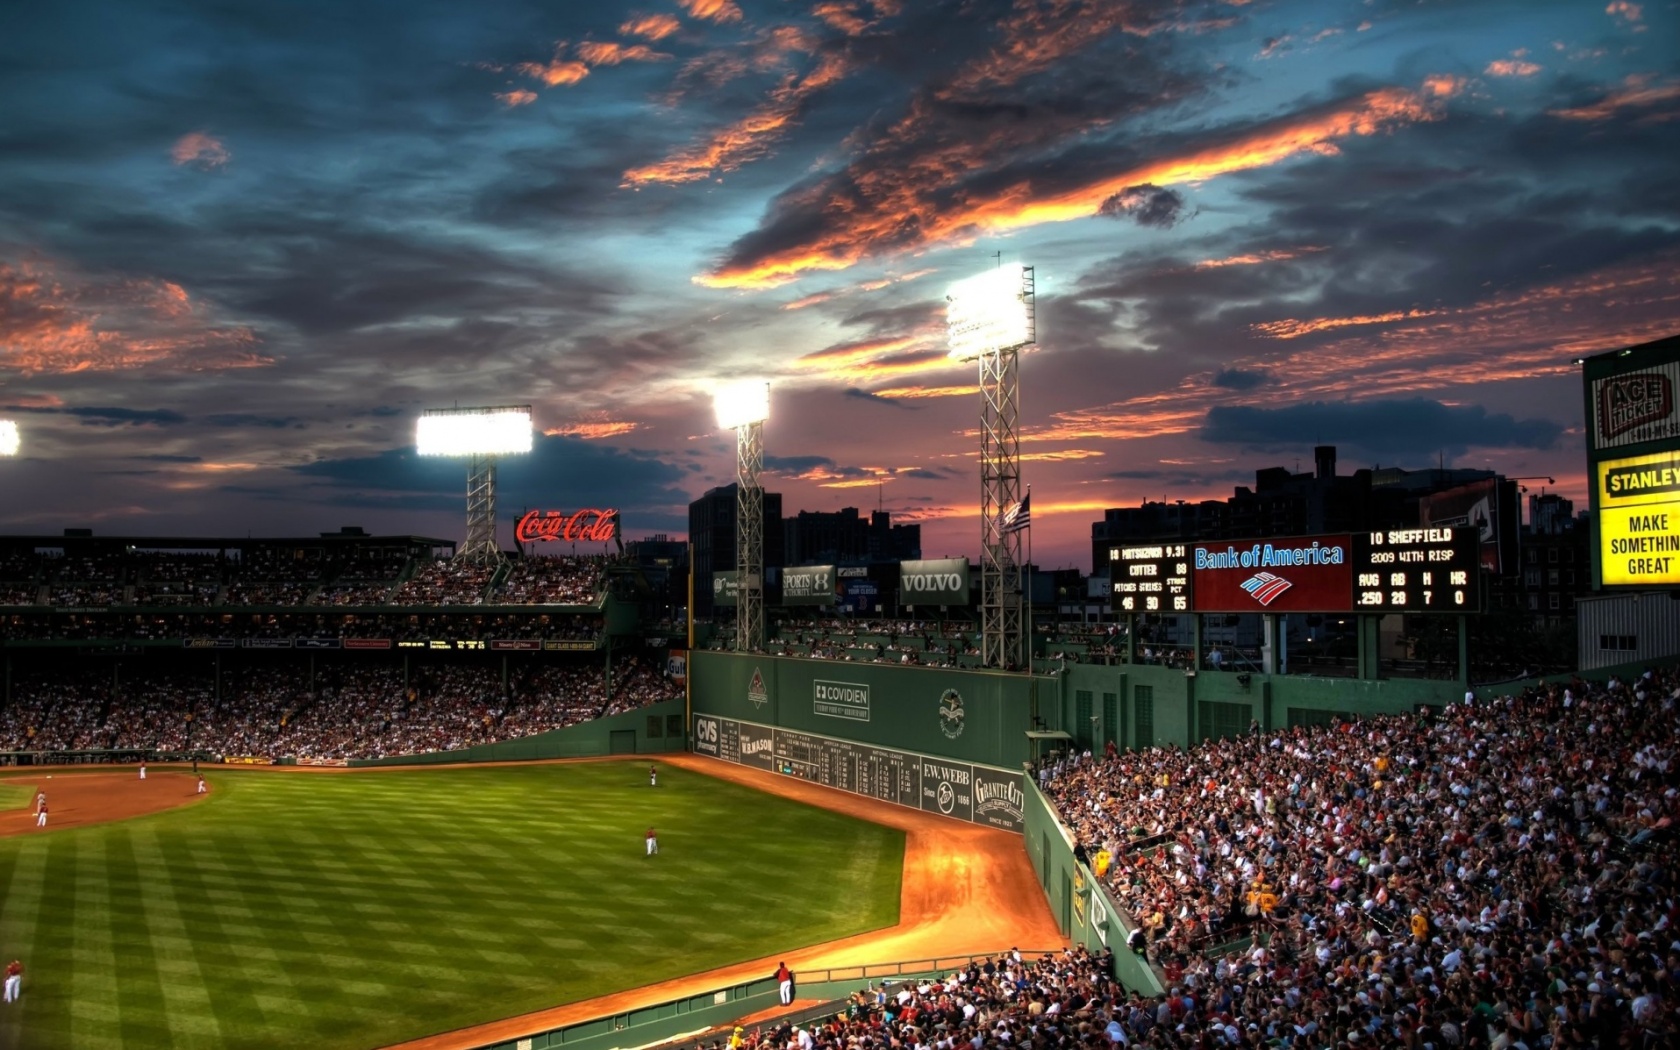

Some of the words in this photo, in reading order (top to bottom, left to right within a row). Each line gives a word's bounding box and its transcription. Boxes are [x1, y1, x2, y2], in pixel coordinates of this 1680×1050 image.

[1612, 380, 1662, 409] ACE
[1612, 401, 1662, 428] TICKET
[1629, 514, 1668, 532] MAKE
[1370, 532, 1383, 545] 10
[1388, 528, 1452, 544] SHEFFIELD
[1166, 546, 1185, 558] 9.31
[1195, 546, 1240, 570] Bank
[1240, 544, 1260, 568] of
[1261, 541, 1344, 566] America
[1371, 552, 1395, 563] 2009
[1399, 551, 1424, 562] WITH
[1428, 550, 1454, 561] RISP
[1130, 564, 1157, 576] CUTTER
[1629, 557, 1670, 575] GREAT
[783, 574, 810, 588] SPORTS
[902, 574, 962, 591] VOLVO
[1358, 574, 1379, 586] AVG
[1391, 572, 1406, 586] AB
[1423, 572, 1432, 586] H
[1450, 571, 1466, 585] HR
[1122, 596, 1134, 610] 46
[1146, 596, 1158, 610] 30
[1174, 596, 1186, 610] 65
[1357, 591, 1383, 605] .250
[1391, 590, 1406, 605] 28
[1423, 590, 1432, 605] 7
[1455, 590, 1463, 605] 0
[828, 686, 866, 704] COVIDIEN
[697, 719, 717, 742] CVS
[924, 764, 940, 779] F.W.
[941, 767, 969, 785] WEBB
[924, 787, 935, 798] Since
[975, 778, 1008, 803] GRANITE
[957, 795, 969, 805] 1866
